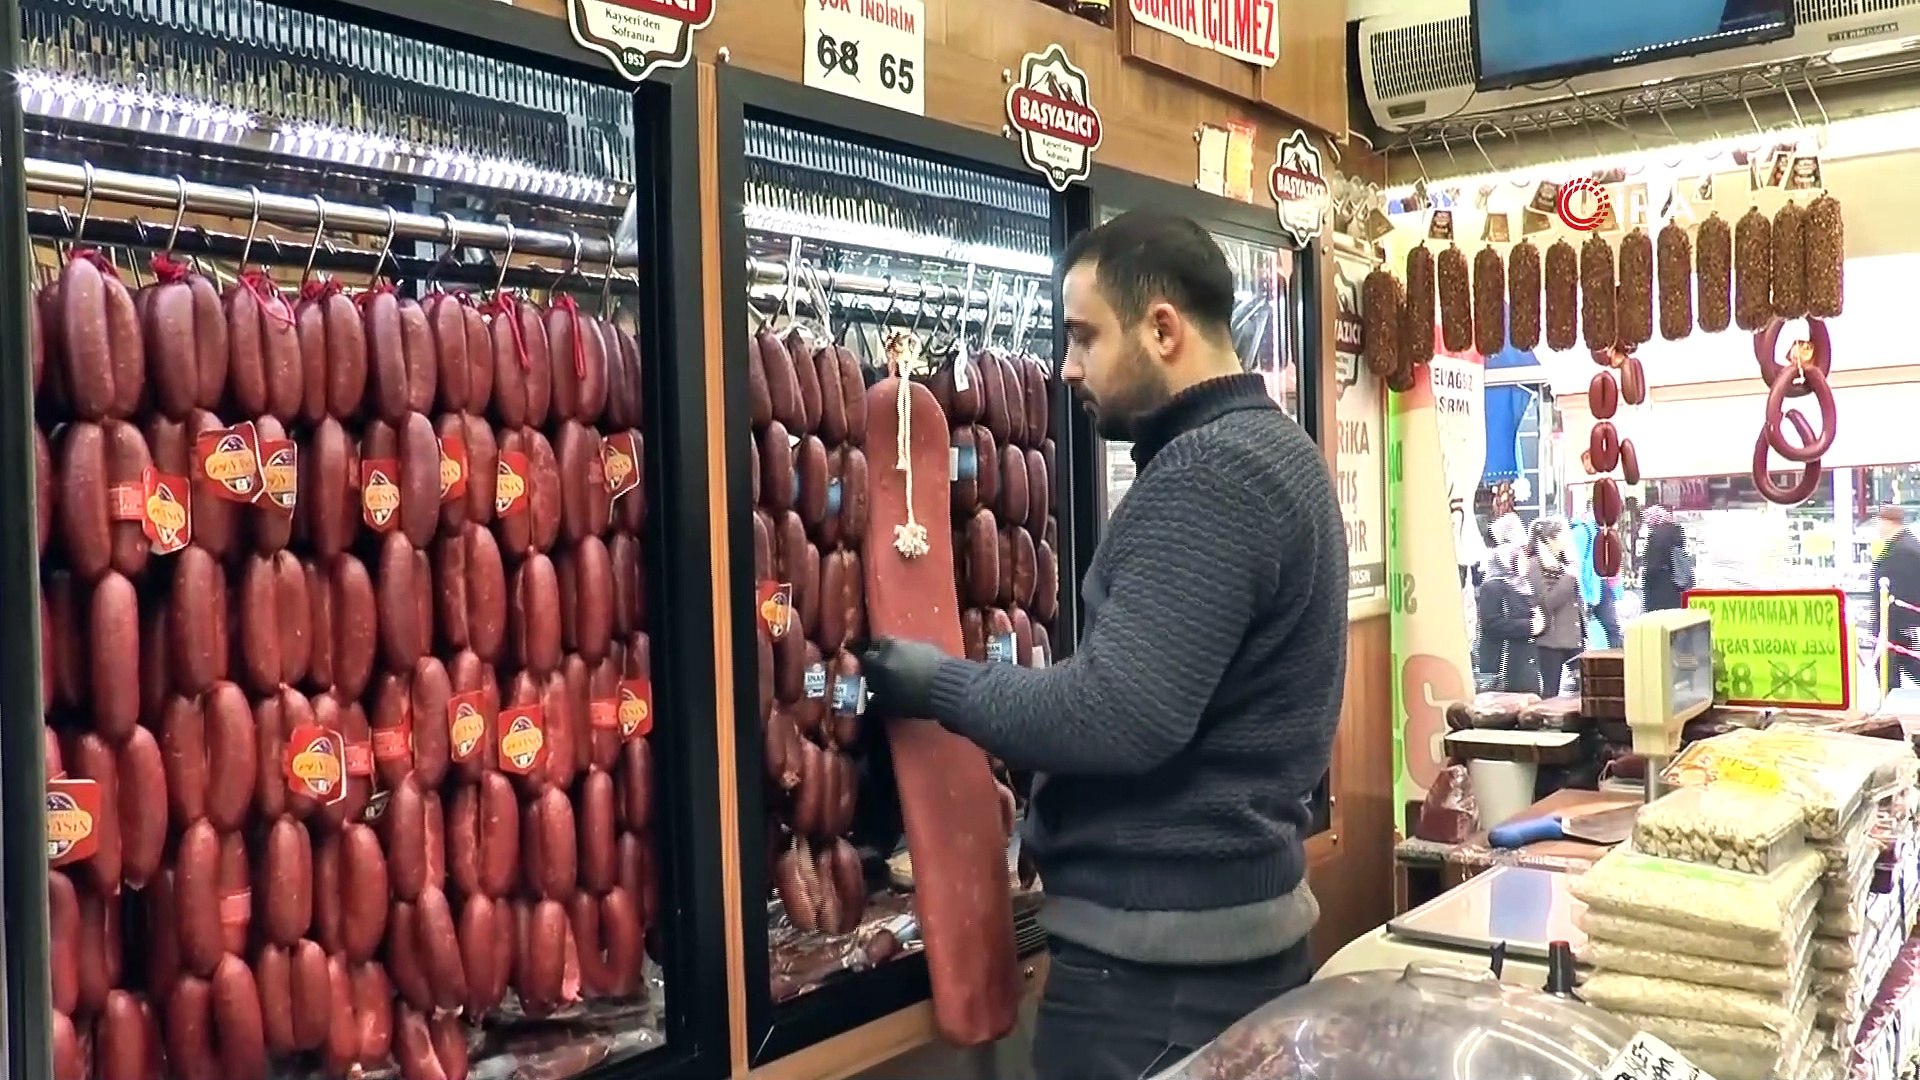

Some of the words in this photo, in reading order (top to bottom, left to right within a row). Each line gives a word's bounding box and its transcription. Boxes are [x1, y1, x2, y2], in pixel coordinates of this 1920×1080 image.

[605, 8, 661, 31] Kayseri'den
[623, 51, 645, 67] 1953
[817, 34, 859, 76] 68
[880, 53, 914, 94] 65
[1020, 96, 1092, 138] BAŞYAZICI
